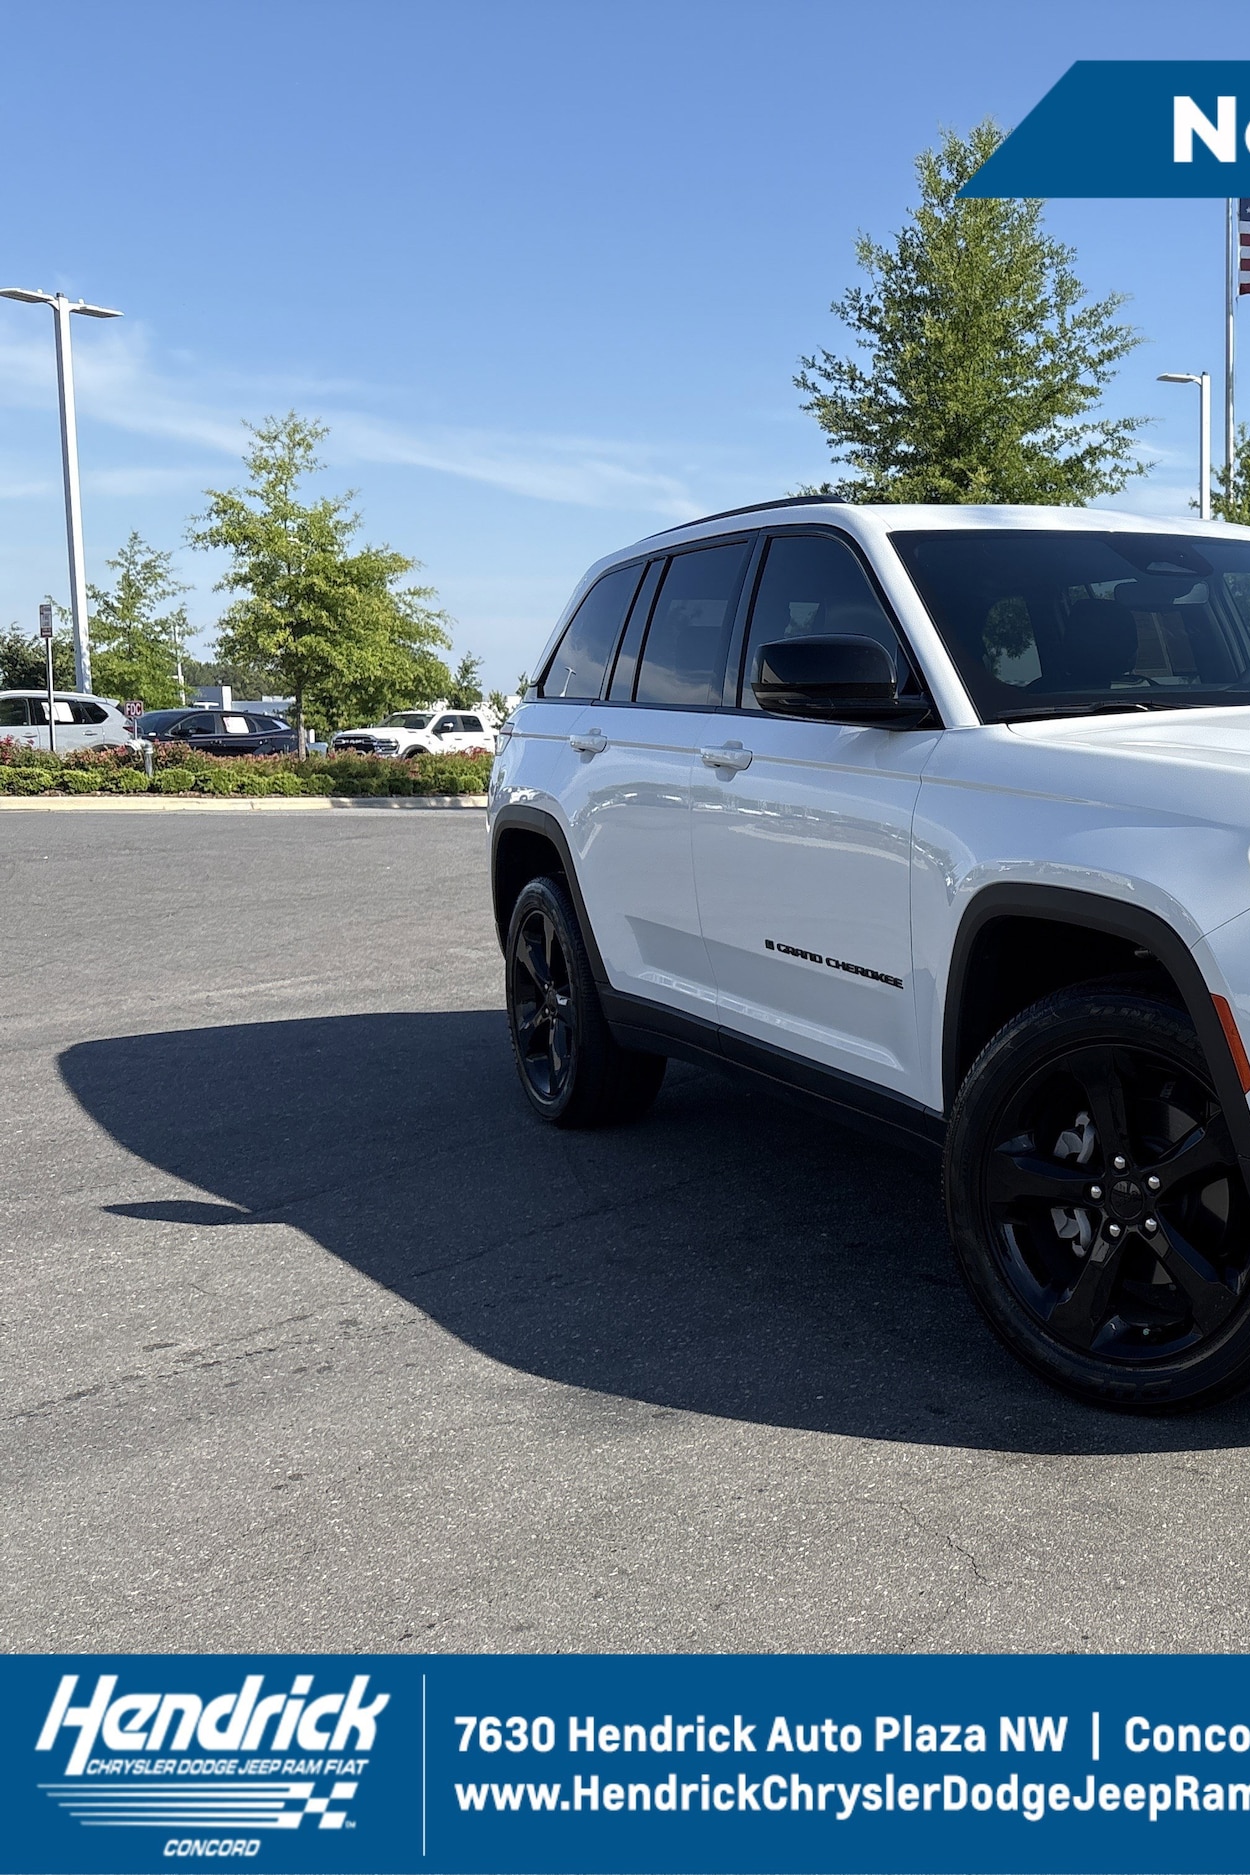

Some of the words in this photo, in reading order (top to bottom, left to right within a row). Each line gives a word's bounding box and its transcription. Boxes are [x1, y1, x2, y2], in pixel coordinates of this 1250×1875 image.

[126, 703, 141, 715] FDC
[777, 943, 823, 964] GRAND
[825, 957, 904, 990] CHEROKEE
